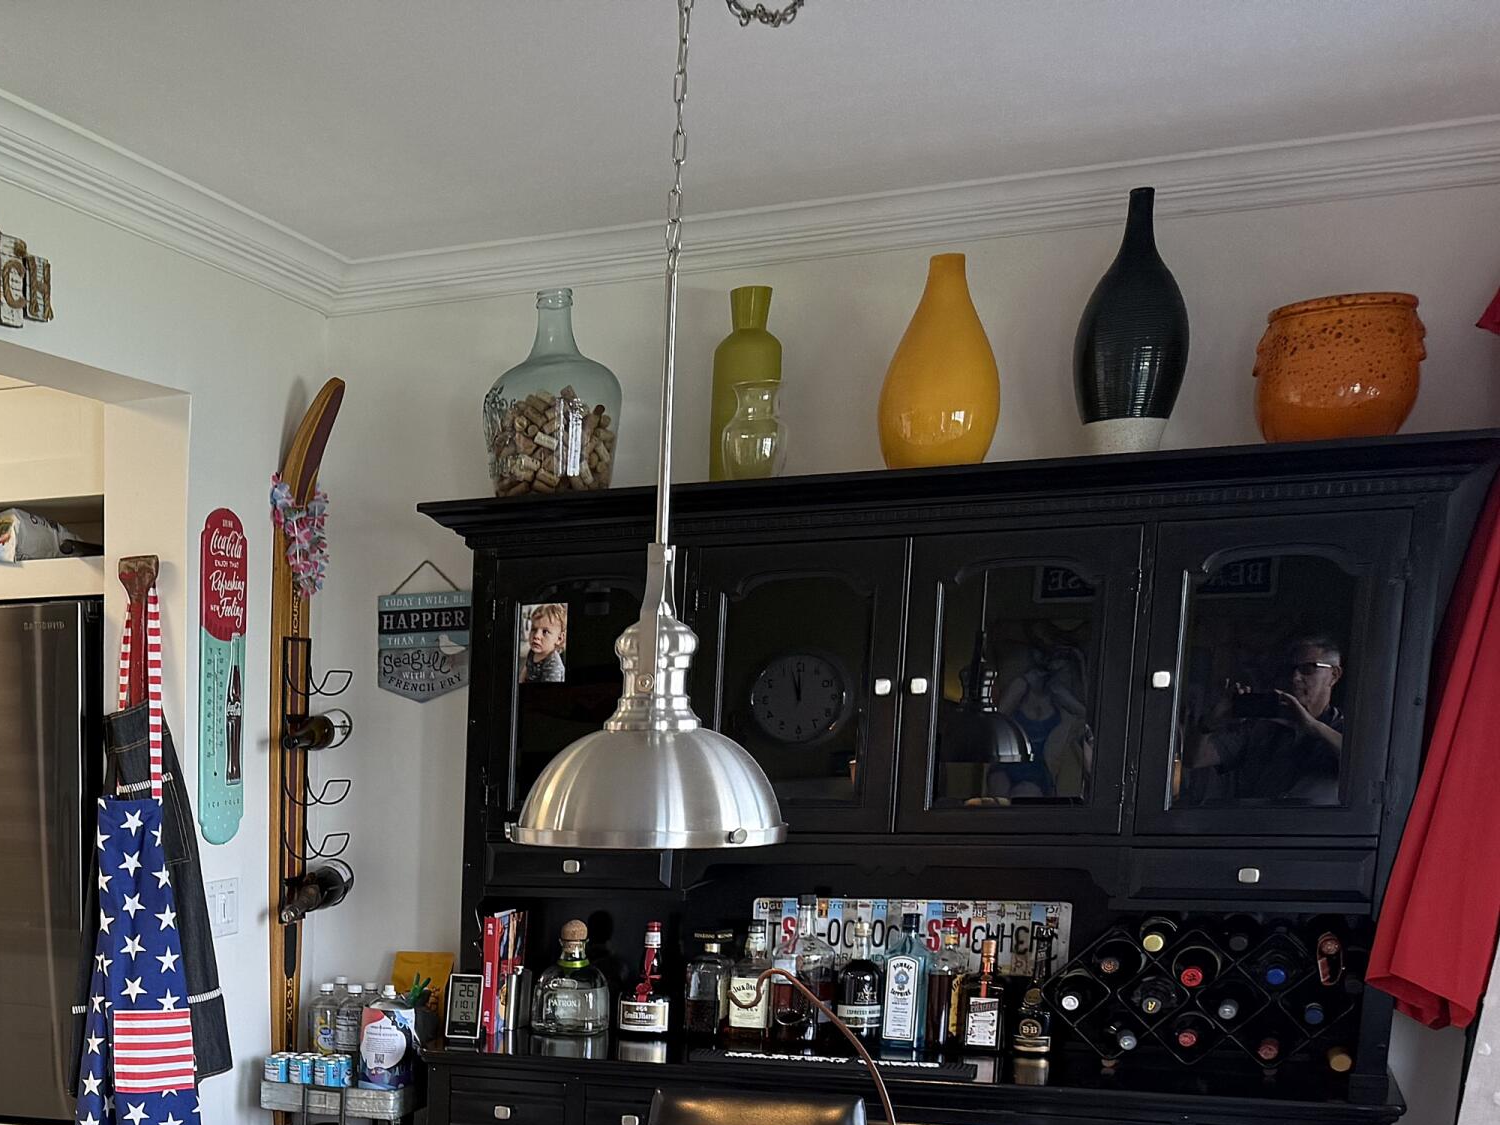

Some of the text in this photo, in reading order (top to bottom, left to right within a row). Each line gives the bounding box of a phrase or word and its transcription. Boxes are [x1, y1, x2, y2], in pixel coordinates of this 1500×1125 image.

[210, 528, 243, 558] Coca-Cola
[209, 570, 245, 600] Refreshing
[385, 598, 414, 607] TODAY
[425, 595, 446, 604] WILL
[454, 596, 465, 604] BE
[218, 596, 244, 628] Feeling
[382, 610, 465, 630] HAPPIER
[387, 636, 426, 646] THAN A
[383, 649, 451, 676] Seagull
[388, 673, 462, 692] FRENCH FRY
[402, 671, 425, 680] WITH
